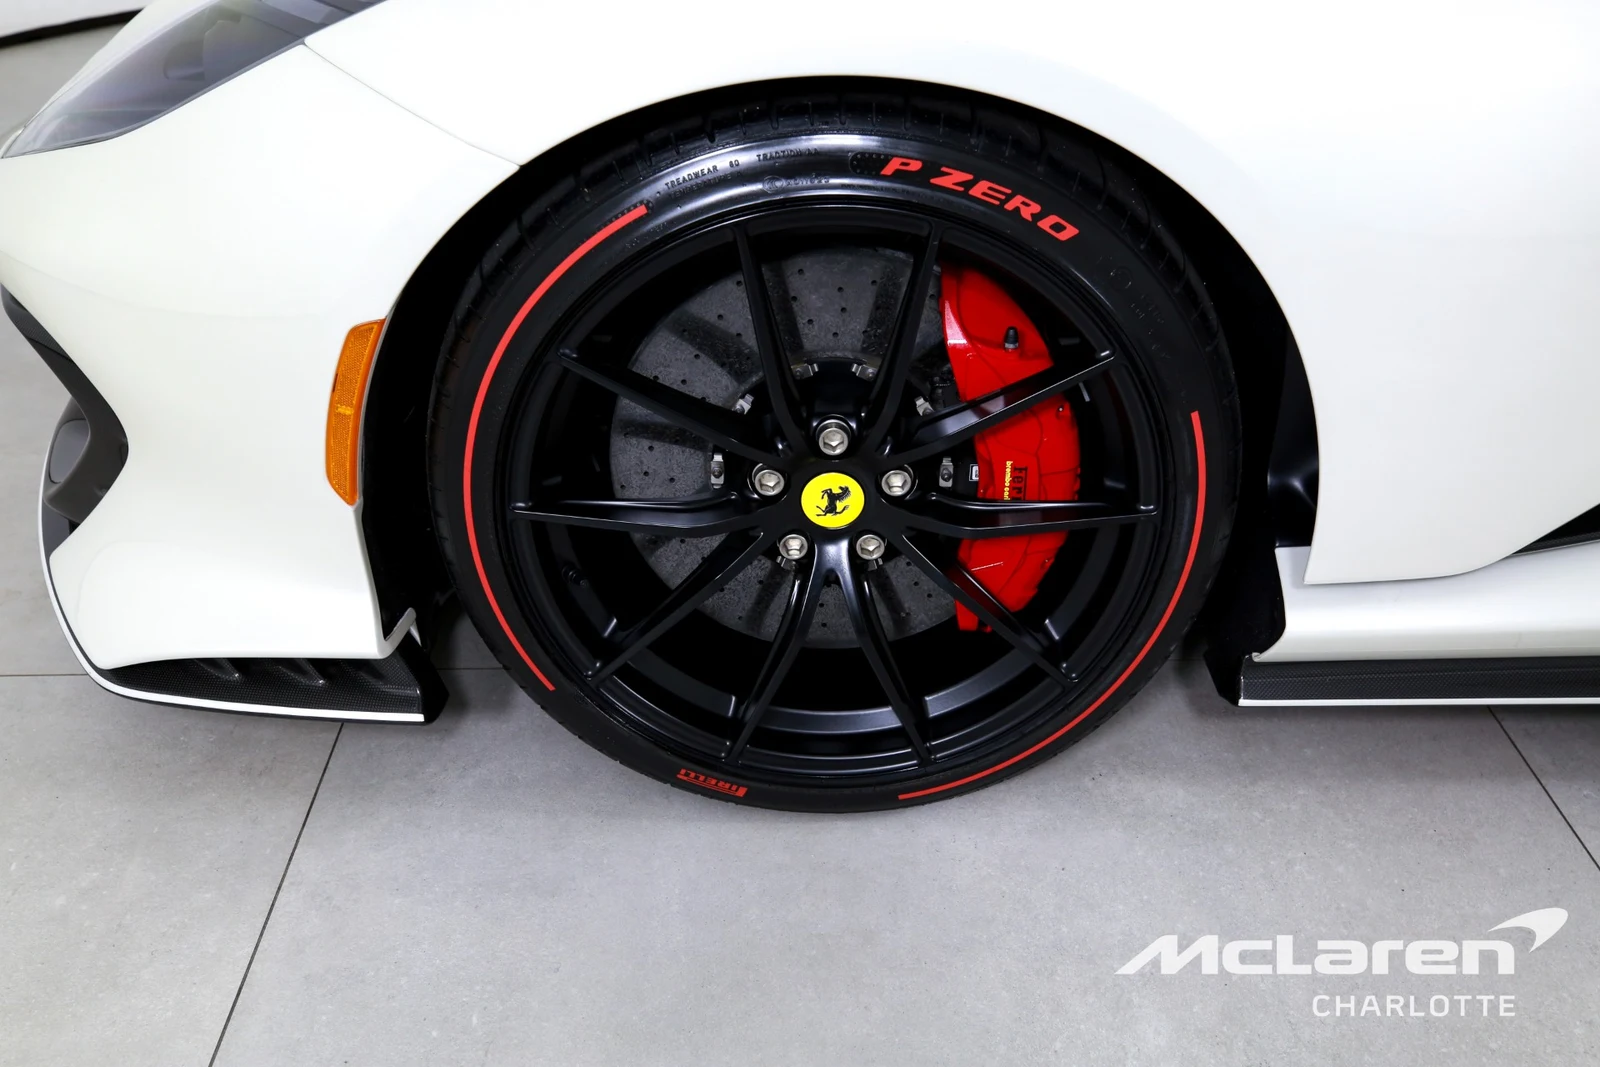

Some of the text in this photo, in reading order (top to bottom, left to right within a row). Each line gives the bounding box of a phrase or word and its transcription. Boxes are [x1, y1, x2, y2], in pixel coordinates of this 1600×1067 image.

[664, 165, 719, 190] TREADWEAR
[756, 148, 802, 163] TRACTION
[881, 157, 1079, 241] P ZERO
[1004, 460, 1013, 486] brembo
[676, 768, 748, 797] PIRELLI
